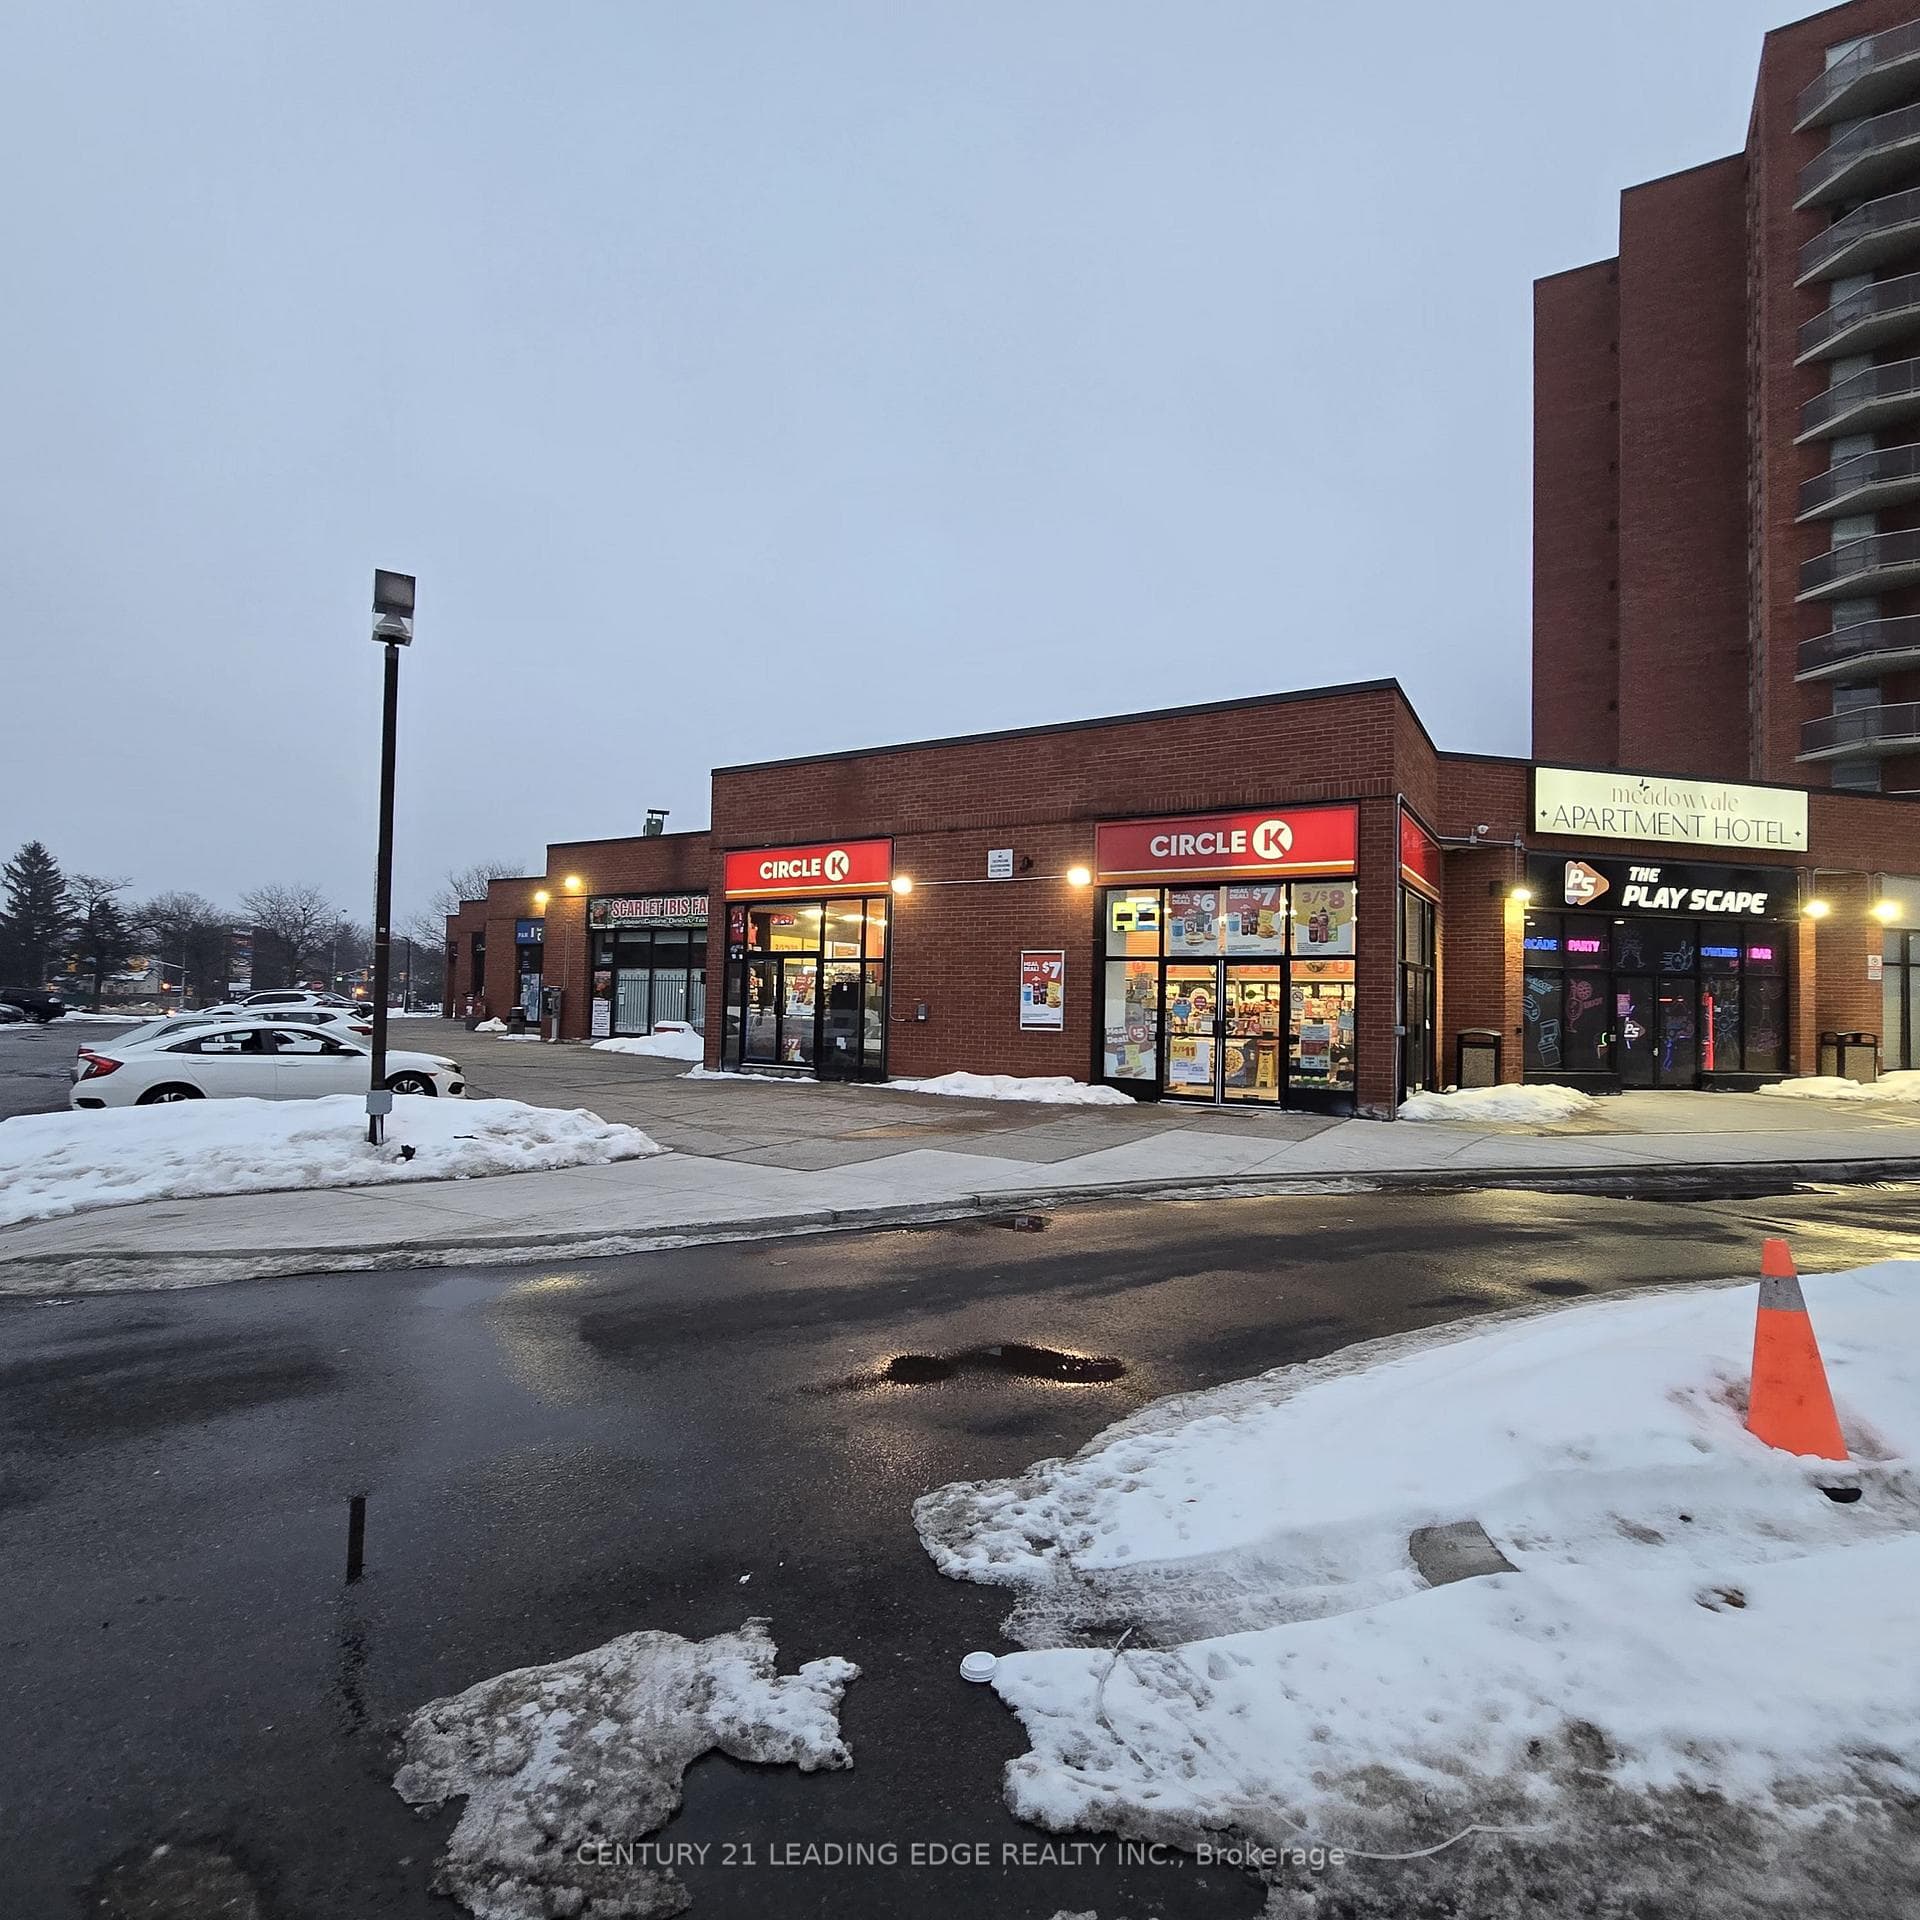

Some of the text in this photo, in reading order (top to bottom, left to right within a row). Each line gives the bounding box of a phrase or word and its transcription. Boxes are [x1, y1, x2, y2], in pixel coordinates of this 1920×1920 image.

[1552, 804, 1792, 845] APARTMENT HOTEL
[1150, 830, 1247, 857] CIRCLE
[759, 858, 822, 880] CIRCLE
[1629, 866, 1661, 883] THE
[611, 895, 709, 918] SCARLET IBIS FA
[1193, 893, 1216, 912] $6
[1252, 887, 1277, 906] $7
[1302, 889, 1345, 910] 3/$8
[1621, 885, 1769, 915] PLAY SCAPE
[1042, 961, 1062, 979] $7
